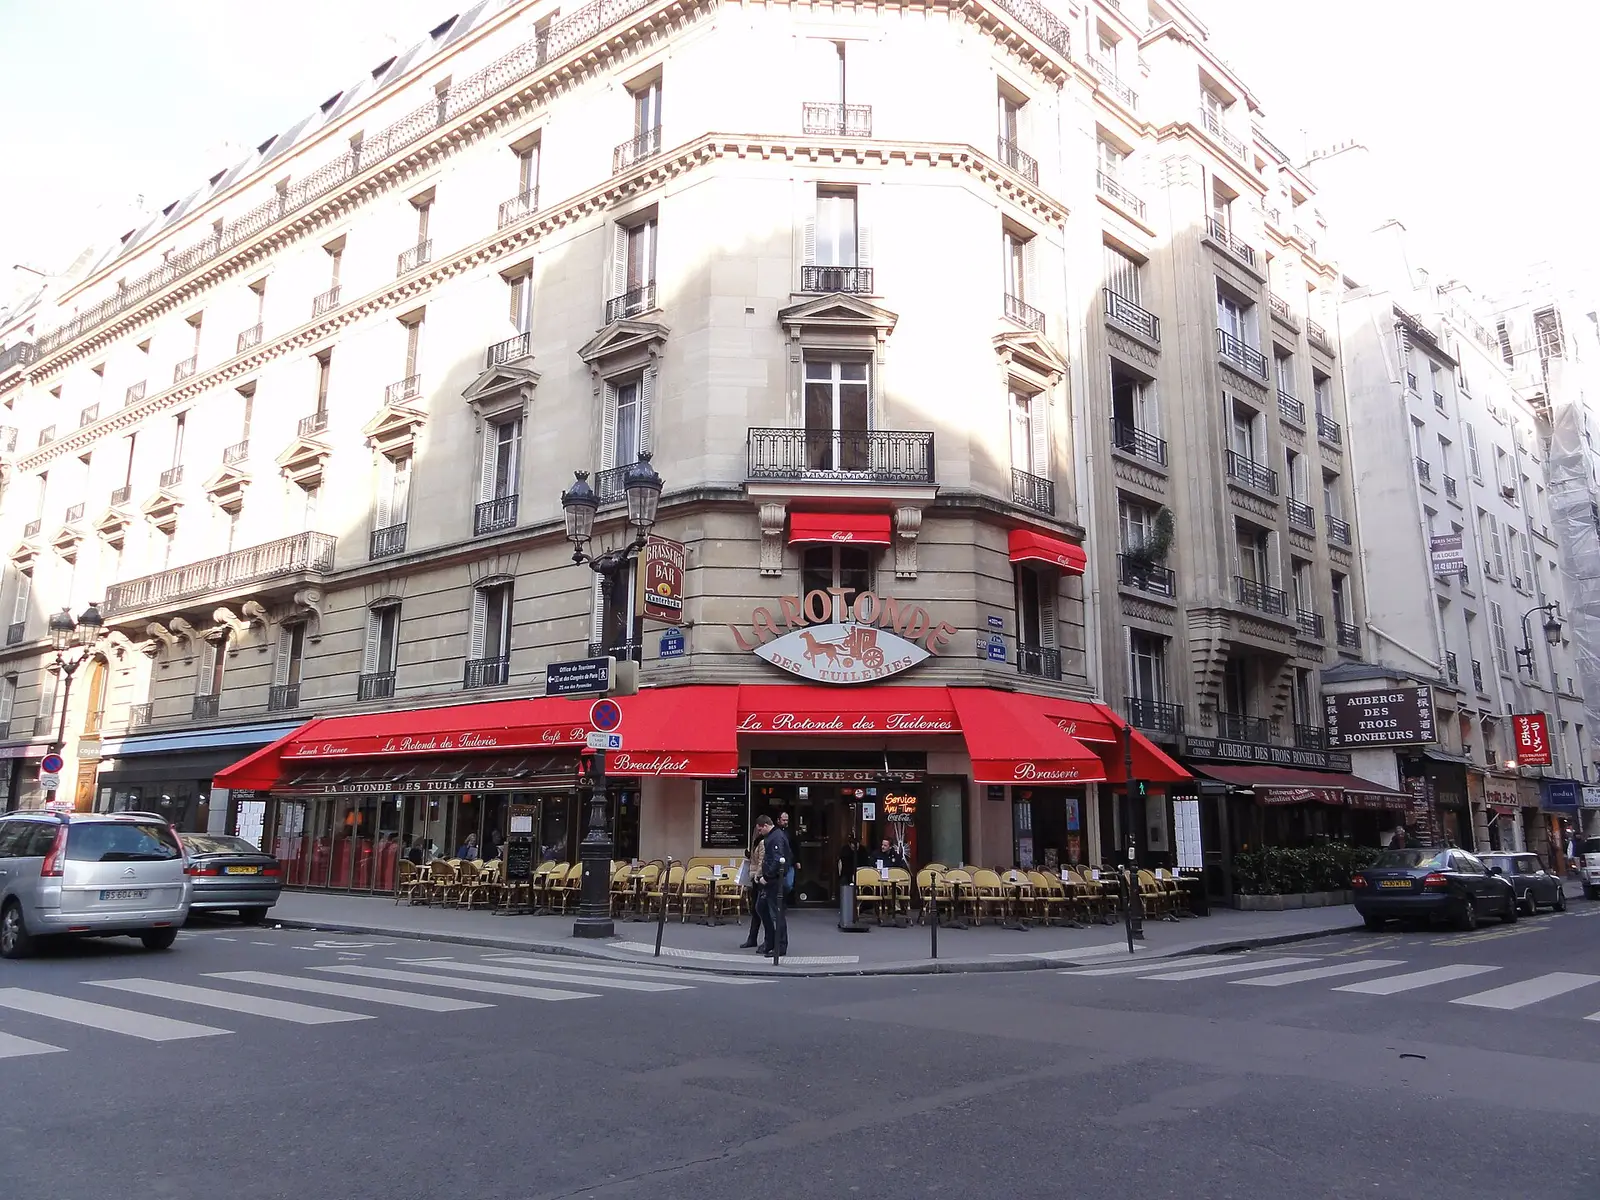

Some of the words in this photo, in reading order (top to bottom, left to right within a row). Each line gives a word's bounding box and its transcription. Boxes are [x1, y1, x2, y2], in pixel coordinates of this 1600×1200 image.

[831, 531, 853, 543] Café
[647, 544, 684, 572] BRASSERIE
[1057, 554, 1070, 566] Café
[655, 564, 675, 584] BAR
[730, 606, 782, 651] LA
[779, 587, 958, 656] ROTONDE
[771, 652, 802, 674] DES
[819, 655, 913, 682] TUILERIES
[1347, 694, 1405, 706] AUBERGE
[1364, 707, 1389, 717] DES
[737, 713, 762, 730] La
[772, 713, 844, 730] Rotonde
[852, 715, 875, 730] des
[886, 713, 952, 730] Tuileries
[1359, 719, 1397, 729] TROIS
[296, 745, 318, 755] Lunch
[323, 743, 348, 754] Dinner
[381, 738, 396, 751] La
[400, 736, 437, 750] Rotonde
[440, 737, 453, 748] des
[459, 732, 497, 747] Tuileries
[542, 730, 561, 745] Café
[1344, 730, 1413, 742] BONHEURS
[1218, 743, 1252, 759] AUBERGE
[1255, 746, 1269, 760] DES
[1271, 748, 1291, 762] TROIS
[1293, 751, 1326, 766] BONHEURS
[613, 753, 690, 776] Breakfast
[1013, 762, 1079, 780] Brasserie
[762, 771, 804, 780] CAFE
[812, 771, 845, 780] THE
[324, 785, 337, 793] LA
[342, 783, 392, 793] ROTONDE
[398, 782, 421, 791] DES
[884, 792, 917, 805] Service
